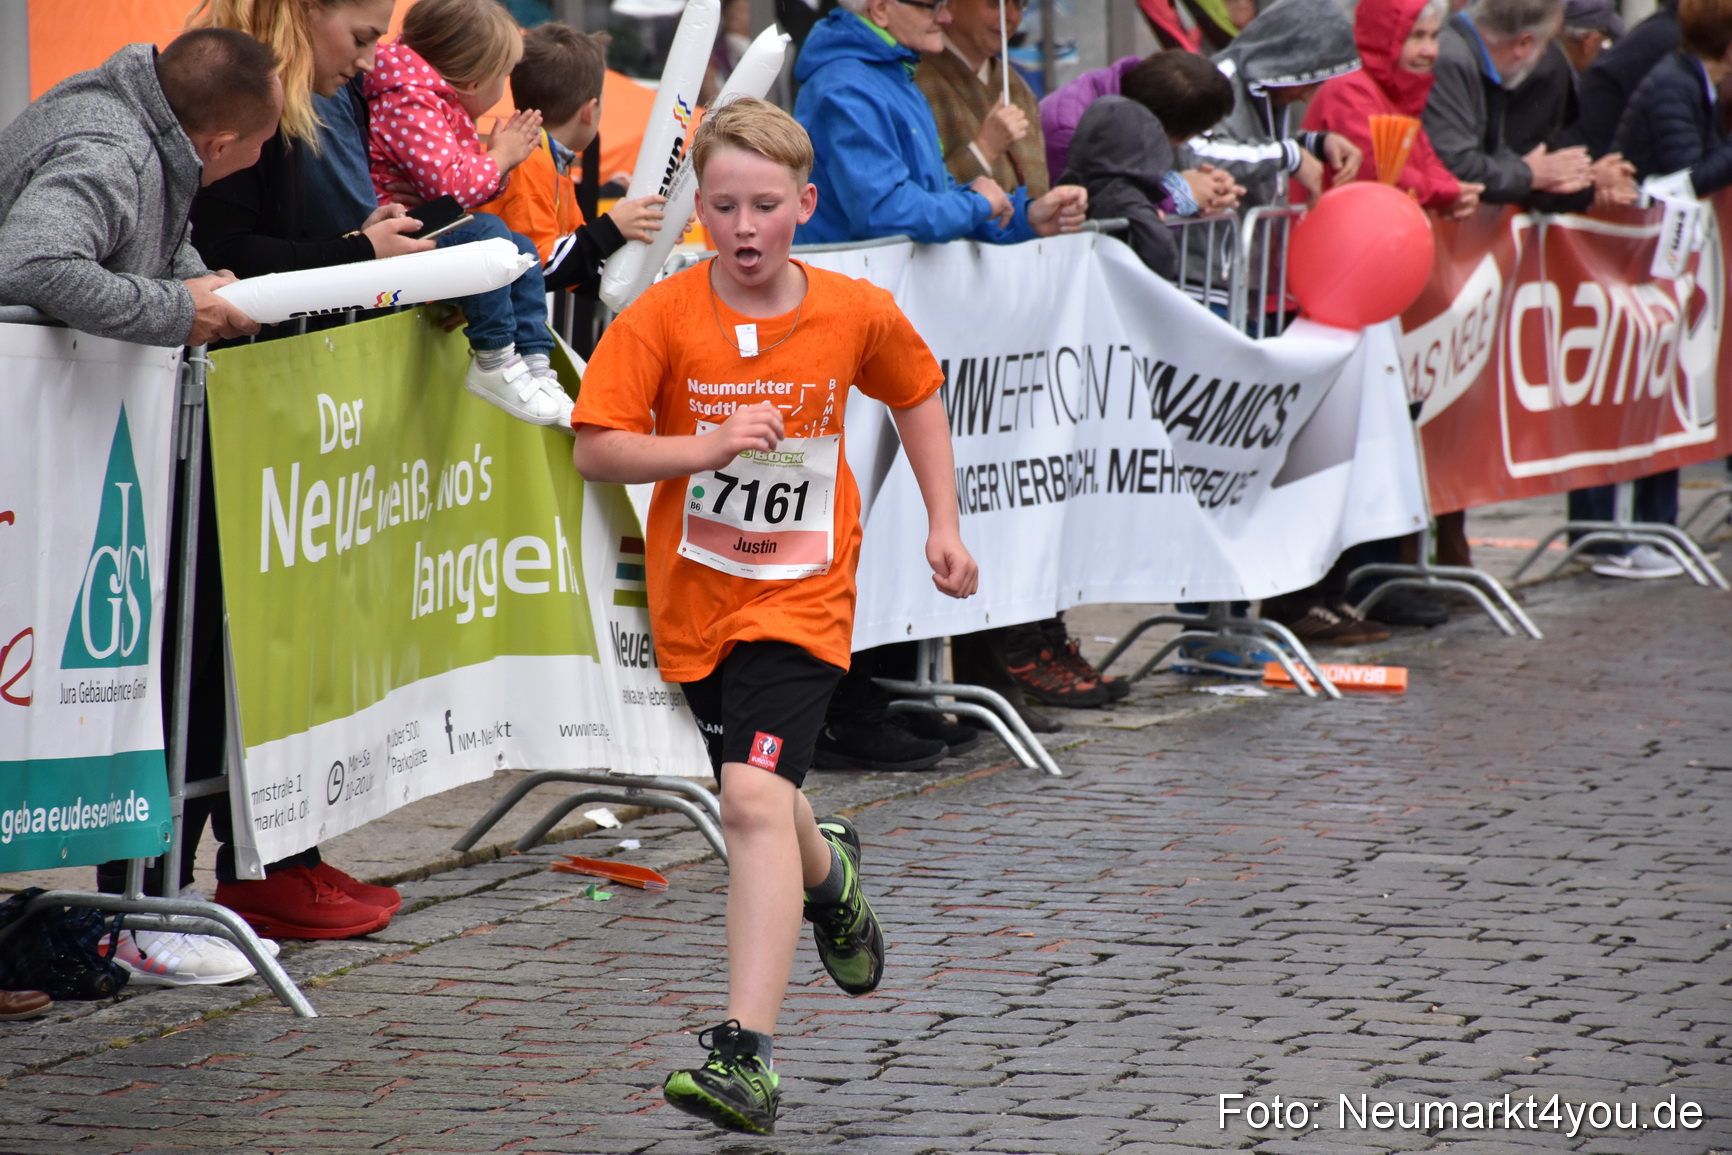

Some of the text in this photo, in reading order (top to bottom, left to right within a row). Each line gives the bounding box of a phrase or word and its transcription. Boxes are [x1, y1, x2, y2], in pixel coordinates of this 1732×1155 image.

[687, 378, 794, 395] Neumarkter
[317, 393, 364, 455] Der
[753, 449, 805, 464] BOCK
[690, 501, 701, 511] B6
[711, 470, 810, 524] 7161
[260, 461, 376, 573] Neue
[733, 537, 777, 554] Justin
[60, 682, 77, 705] Jura
[405, 720, 420, 742] 500
[296, 773, 302, 793] 1
